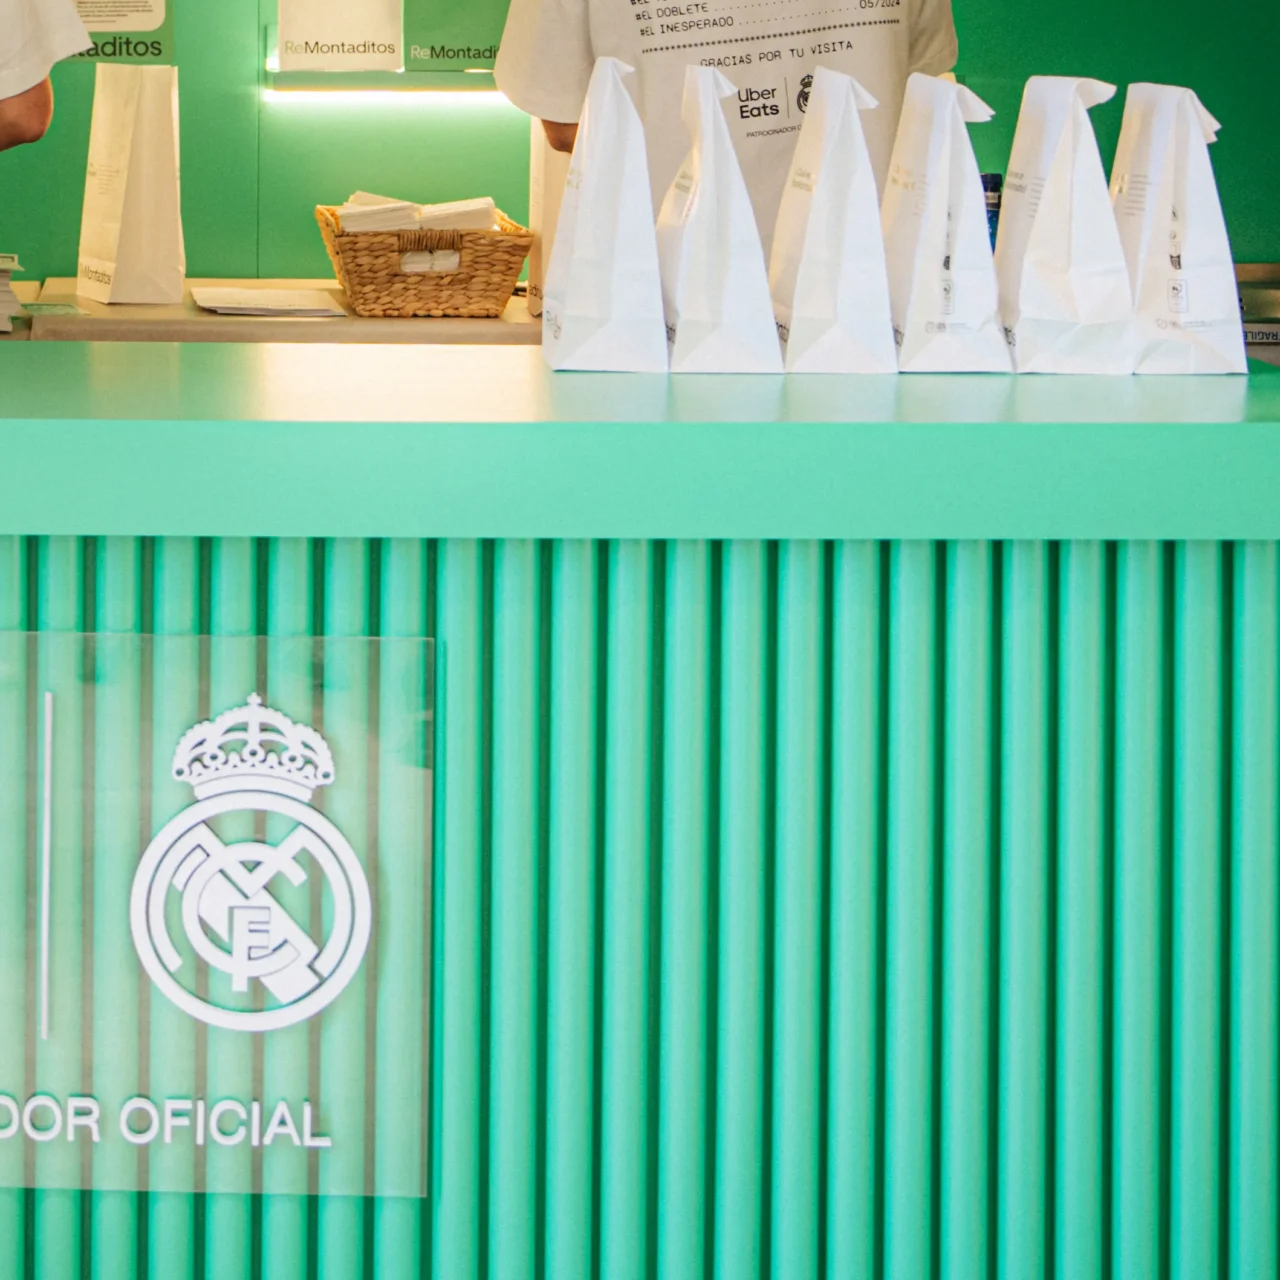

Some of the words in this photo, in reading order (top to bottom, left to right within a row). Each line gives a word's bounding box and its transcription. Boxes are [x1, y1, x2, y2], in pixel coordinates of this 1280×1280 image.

[635, 10, 653, 21] #EL
[656, 2, 709, 18] DOBLETE
[640, 26, 655, 36] #EL
[660, 16, 734, 34] INESPERADO
[285, 41, 395, 55] ReMontaditos
[410, 45, 499, 61] ReMontadi
[700, 54, 752, 67] GRACIAS
[759, 51, 782, 62] POR
[789, 48, 805, 58] TU
[810, 40, 853, 55] VISITA
[737, 87, 777, 103] Uber
[739, 103, 780, 119] Eats
[746, 125, 796, 138] PATROCINADOR
[1243, 330, 1280, 341] RAGILE
[120, 1096, 332, 1147] OFICIAL
